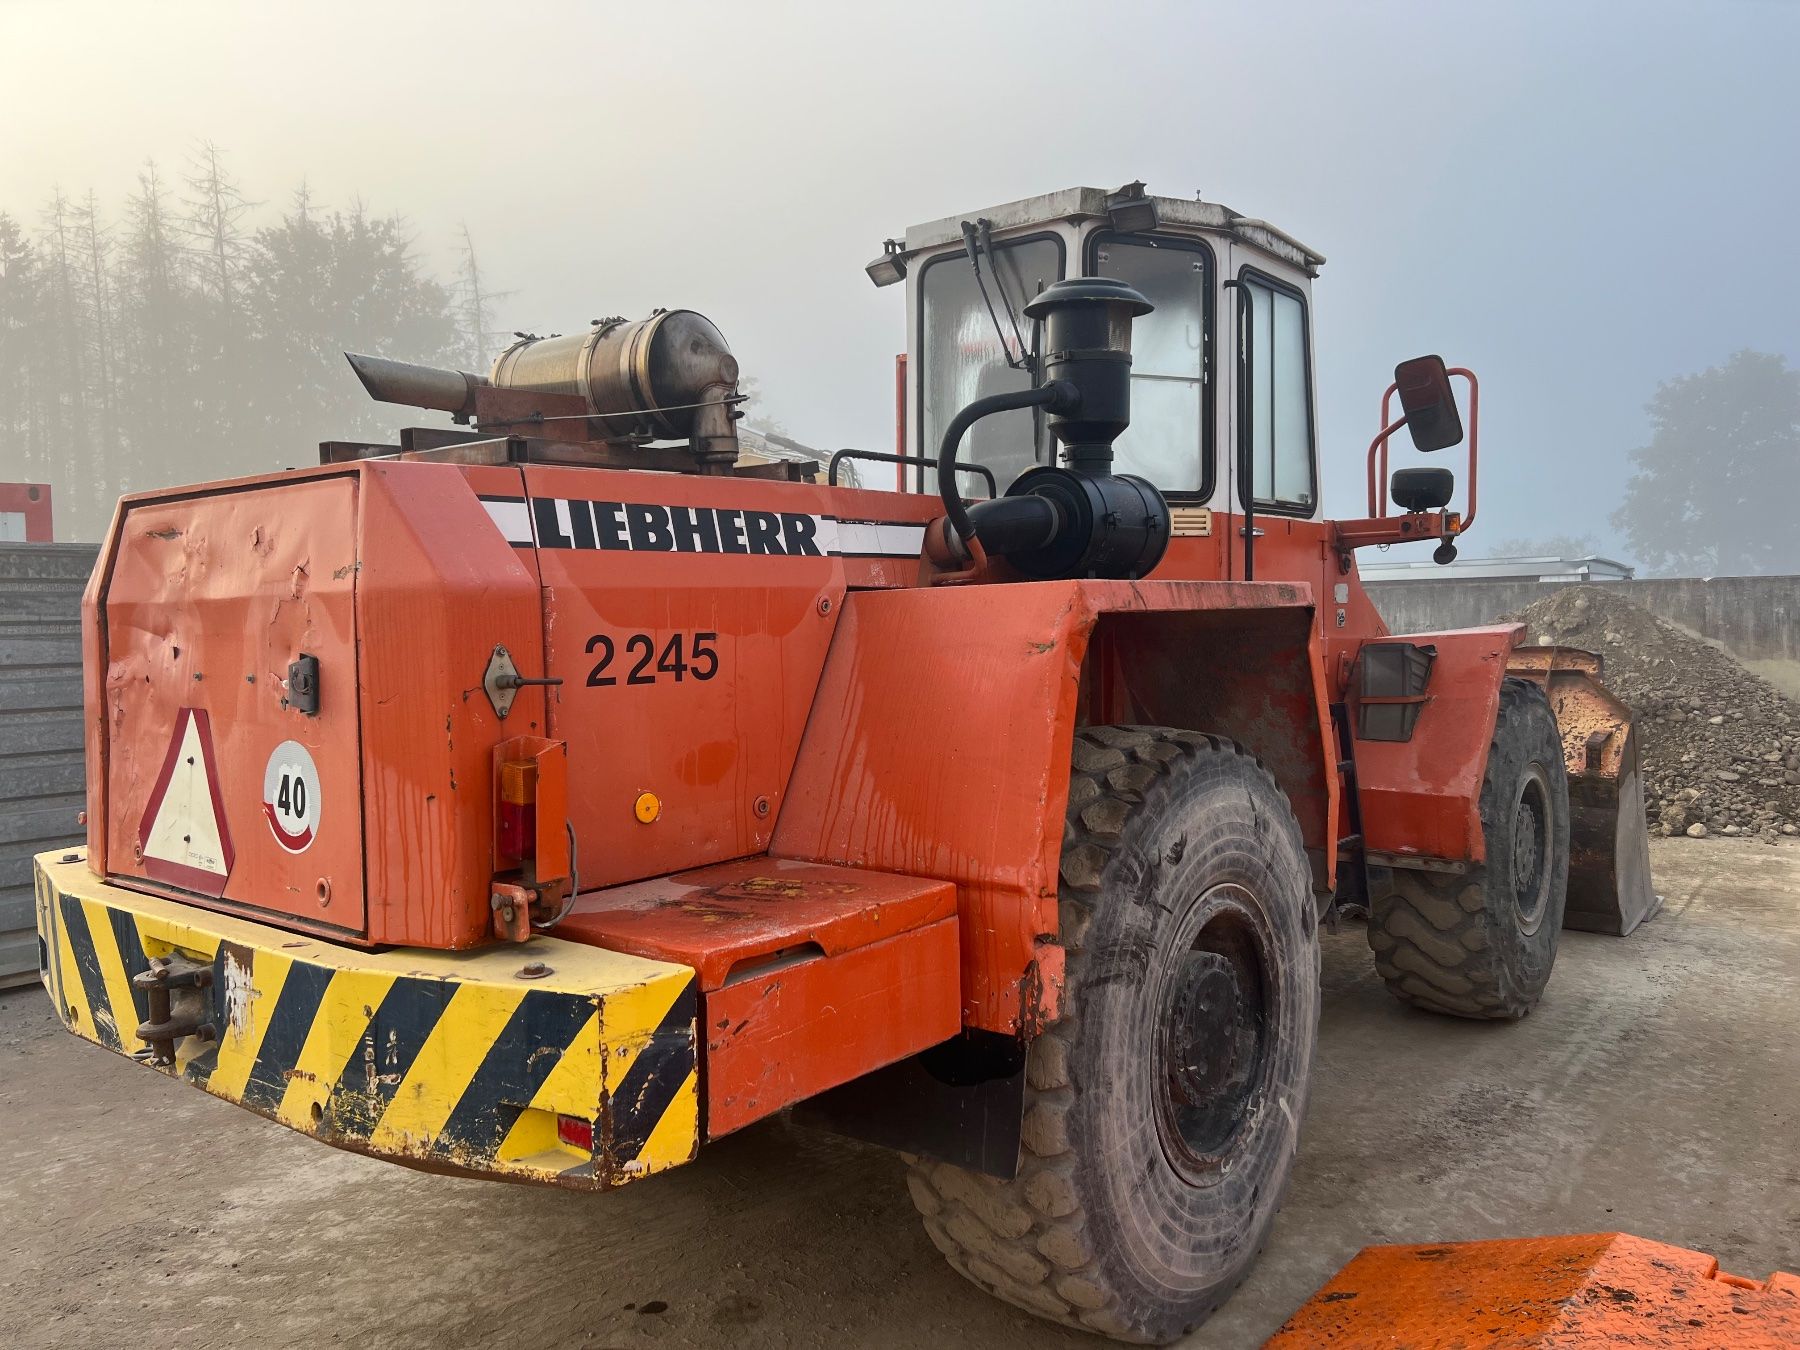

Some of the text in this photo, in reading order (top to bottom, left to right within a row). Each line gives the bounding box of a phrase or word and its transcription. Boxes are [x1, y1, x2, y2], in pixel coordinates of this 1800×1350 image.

[532, 497, 823, 556] LIEBHERR
[585, 632, 719, 687] 2245
[277, 774, 306, 819] 40
